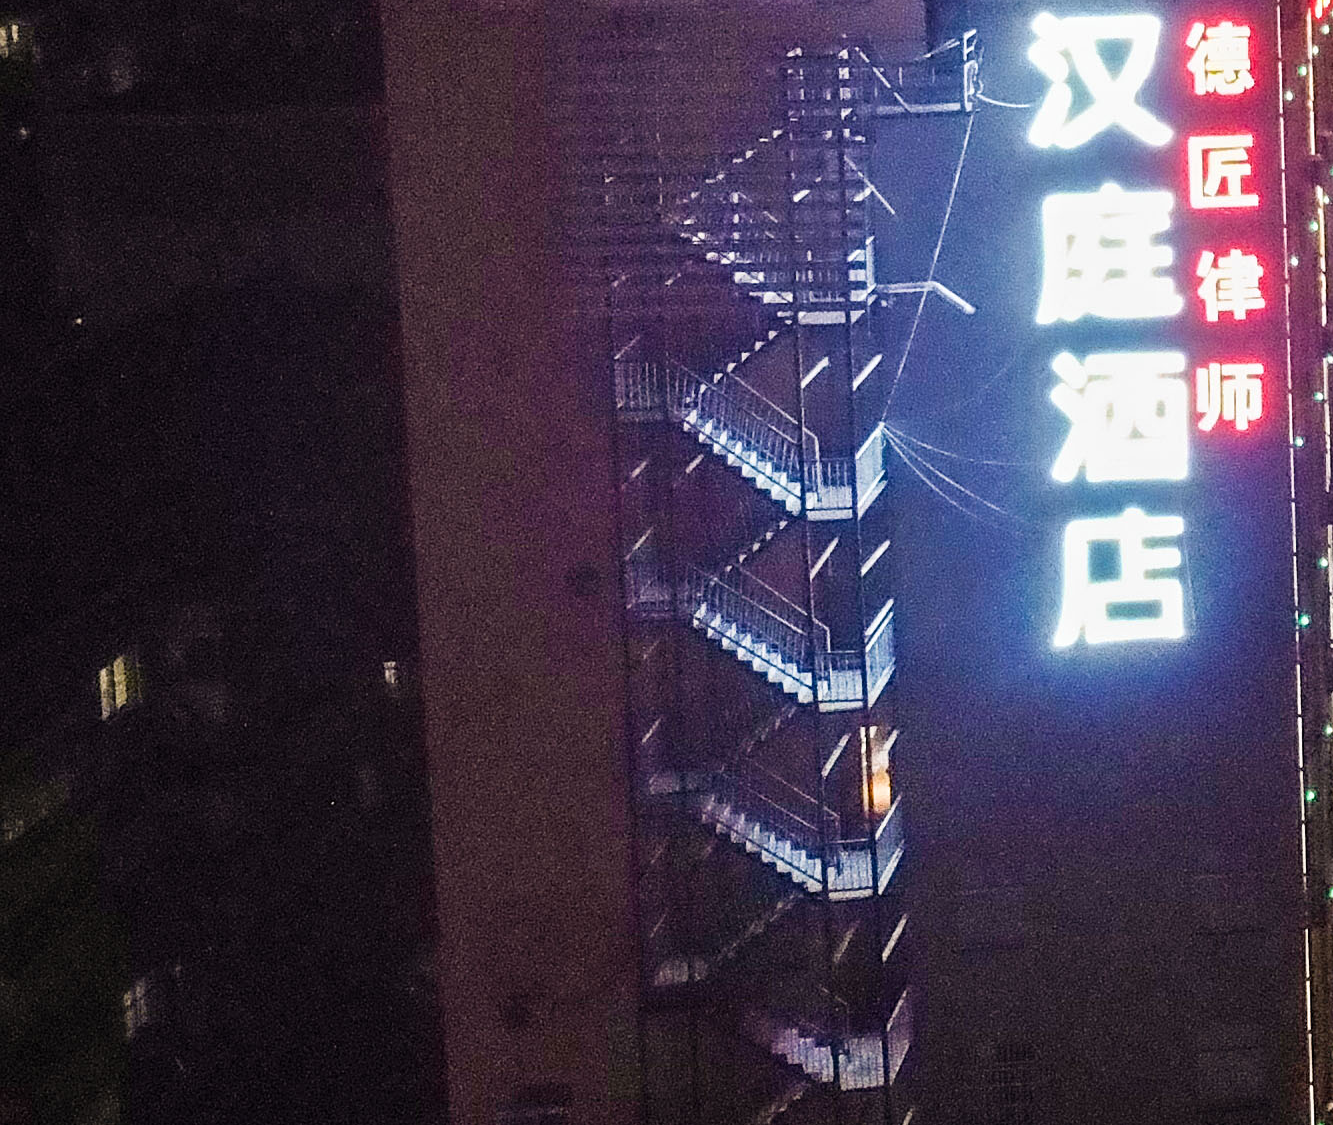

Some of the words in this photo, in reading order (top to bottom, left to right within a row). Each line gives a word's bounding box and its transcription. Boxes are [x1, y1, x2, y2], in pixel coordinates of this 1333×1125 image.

[1027, 12, 1190, 648] 汉庭酒店
[1186, 22, 1265, 431] 德匠律师
